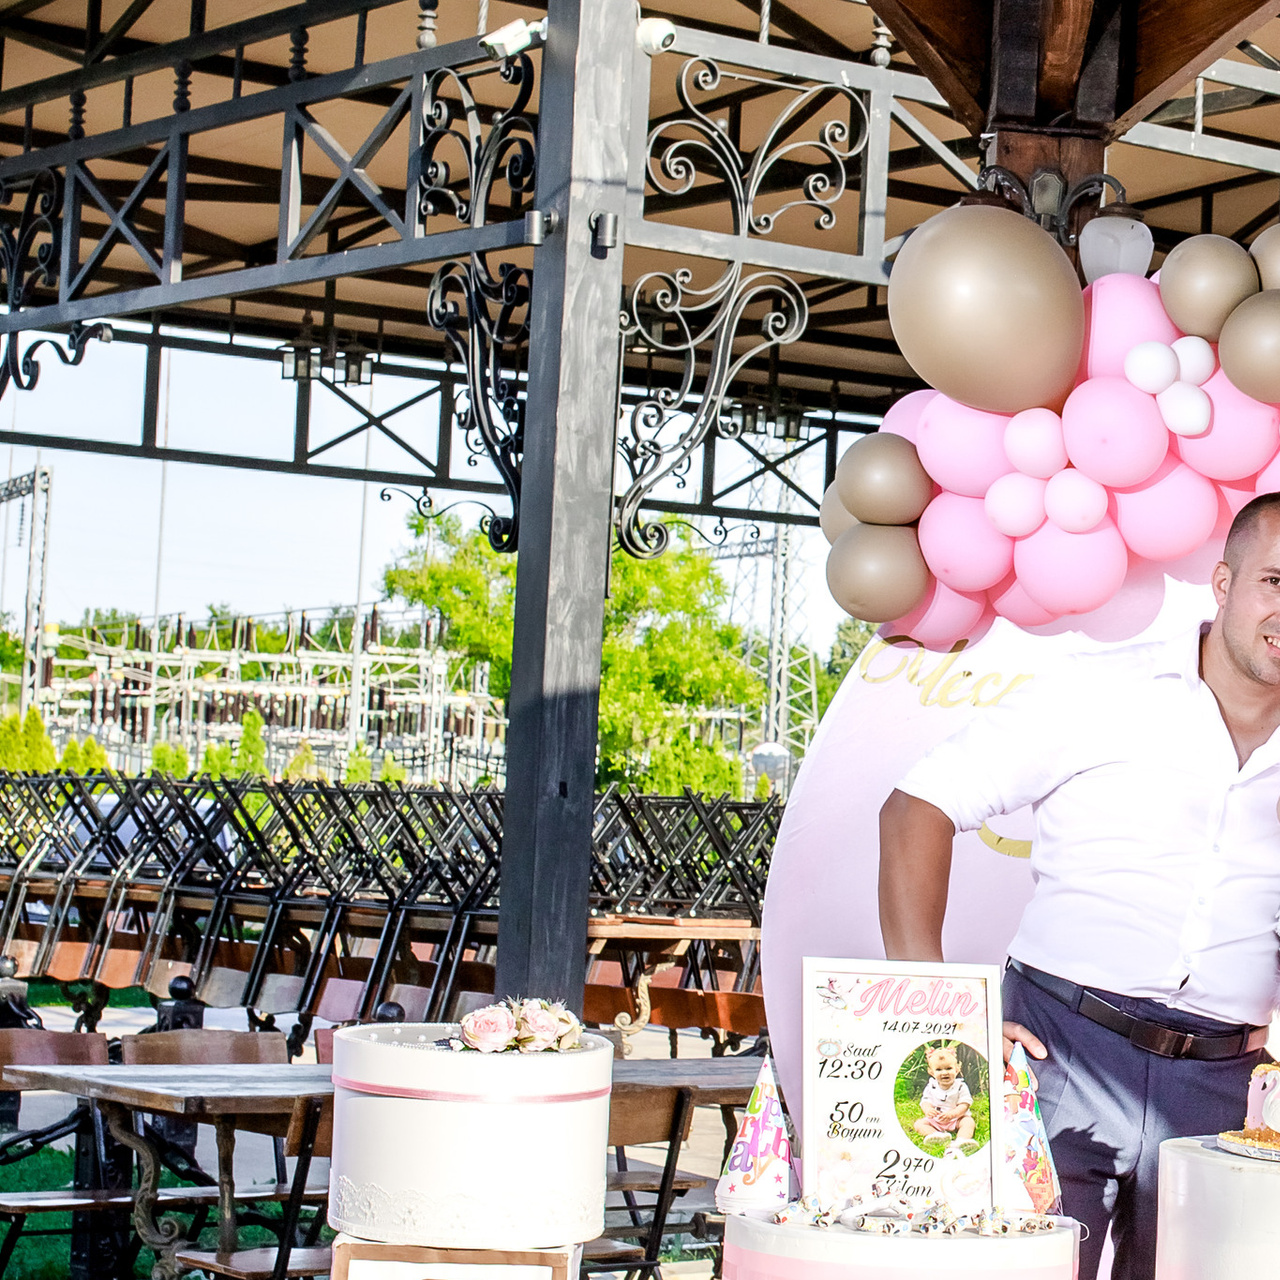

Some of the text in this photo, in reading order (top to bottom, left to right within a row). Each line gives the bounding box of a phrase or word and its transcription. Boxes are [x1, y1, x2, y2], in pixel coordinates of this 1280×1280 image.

[853, 977, 979, 1018] Melin
[842, 1042, 882, 1058] Saat
[818, 1058, 882, 1080] 12:30
[829, 1100, 880, 1124] 50 cm
[826, 1121, 884, 1143] Boyum
